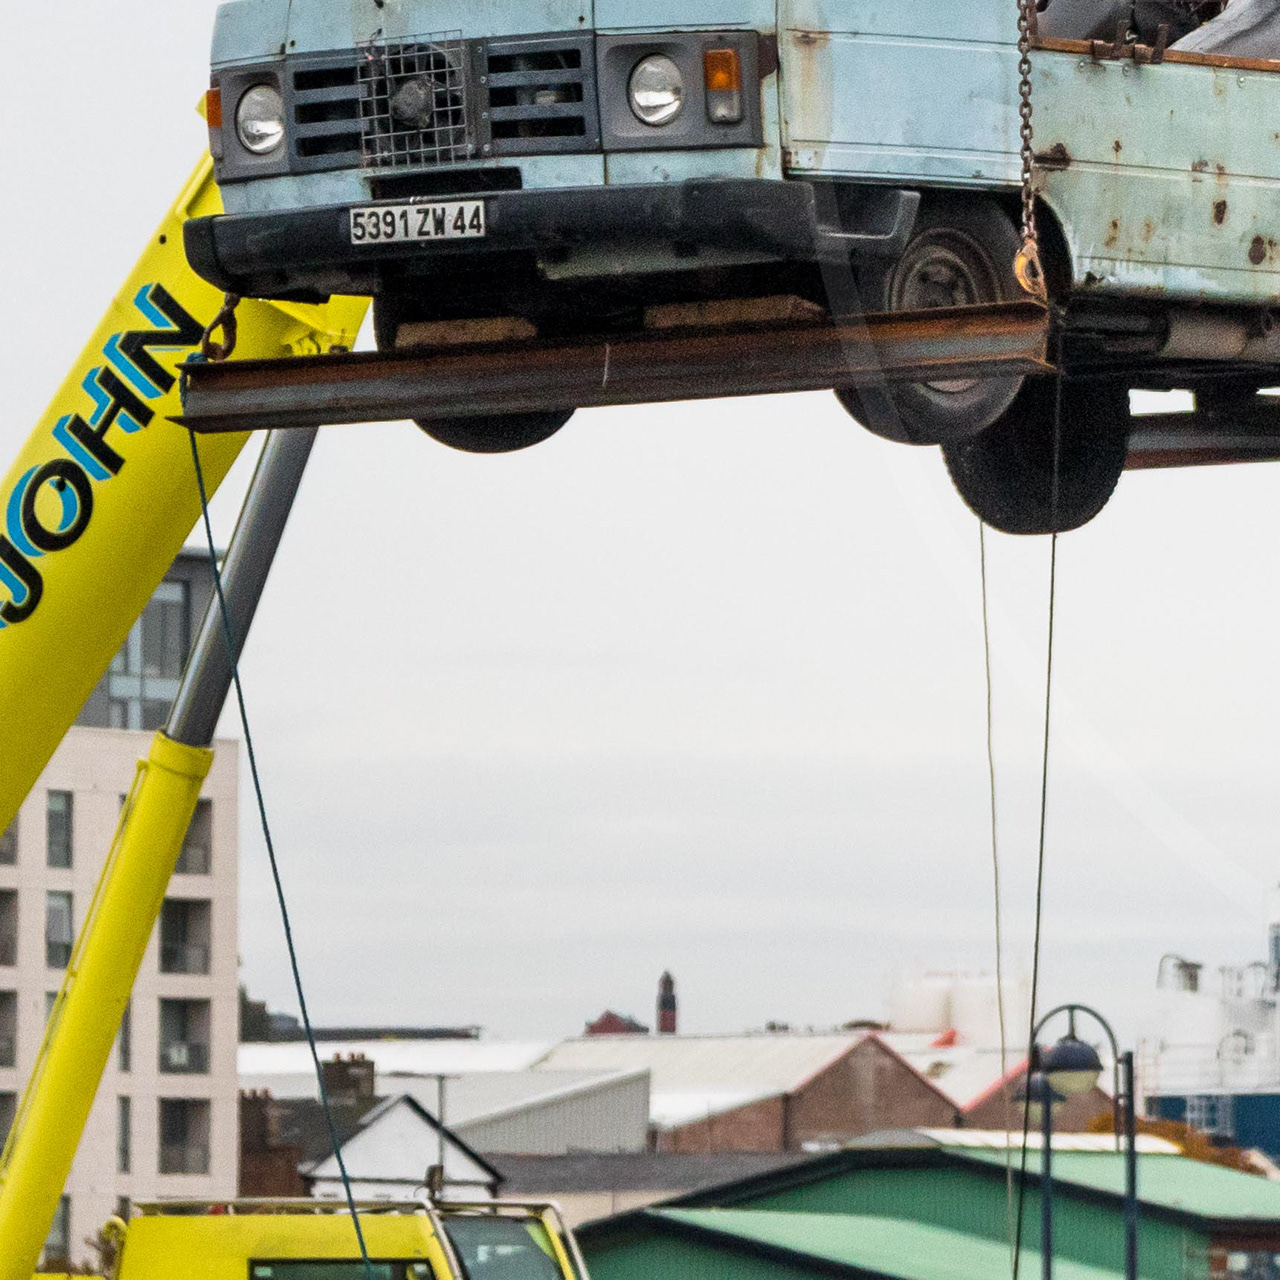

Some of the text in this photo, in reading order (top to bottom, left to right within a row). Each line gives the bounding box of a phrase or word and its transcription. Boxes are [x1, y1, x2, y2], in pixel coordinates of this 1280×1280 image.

[352, 205, 482, 241] 5391 ZW 44
[0, 282, 206, 627] JOHN
